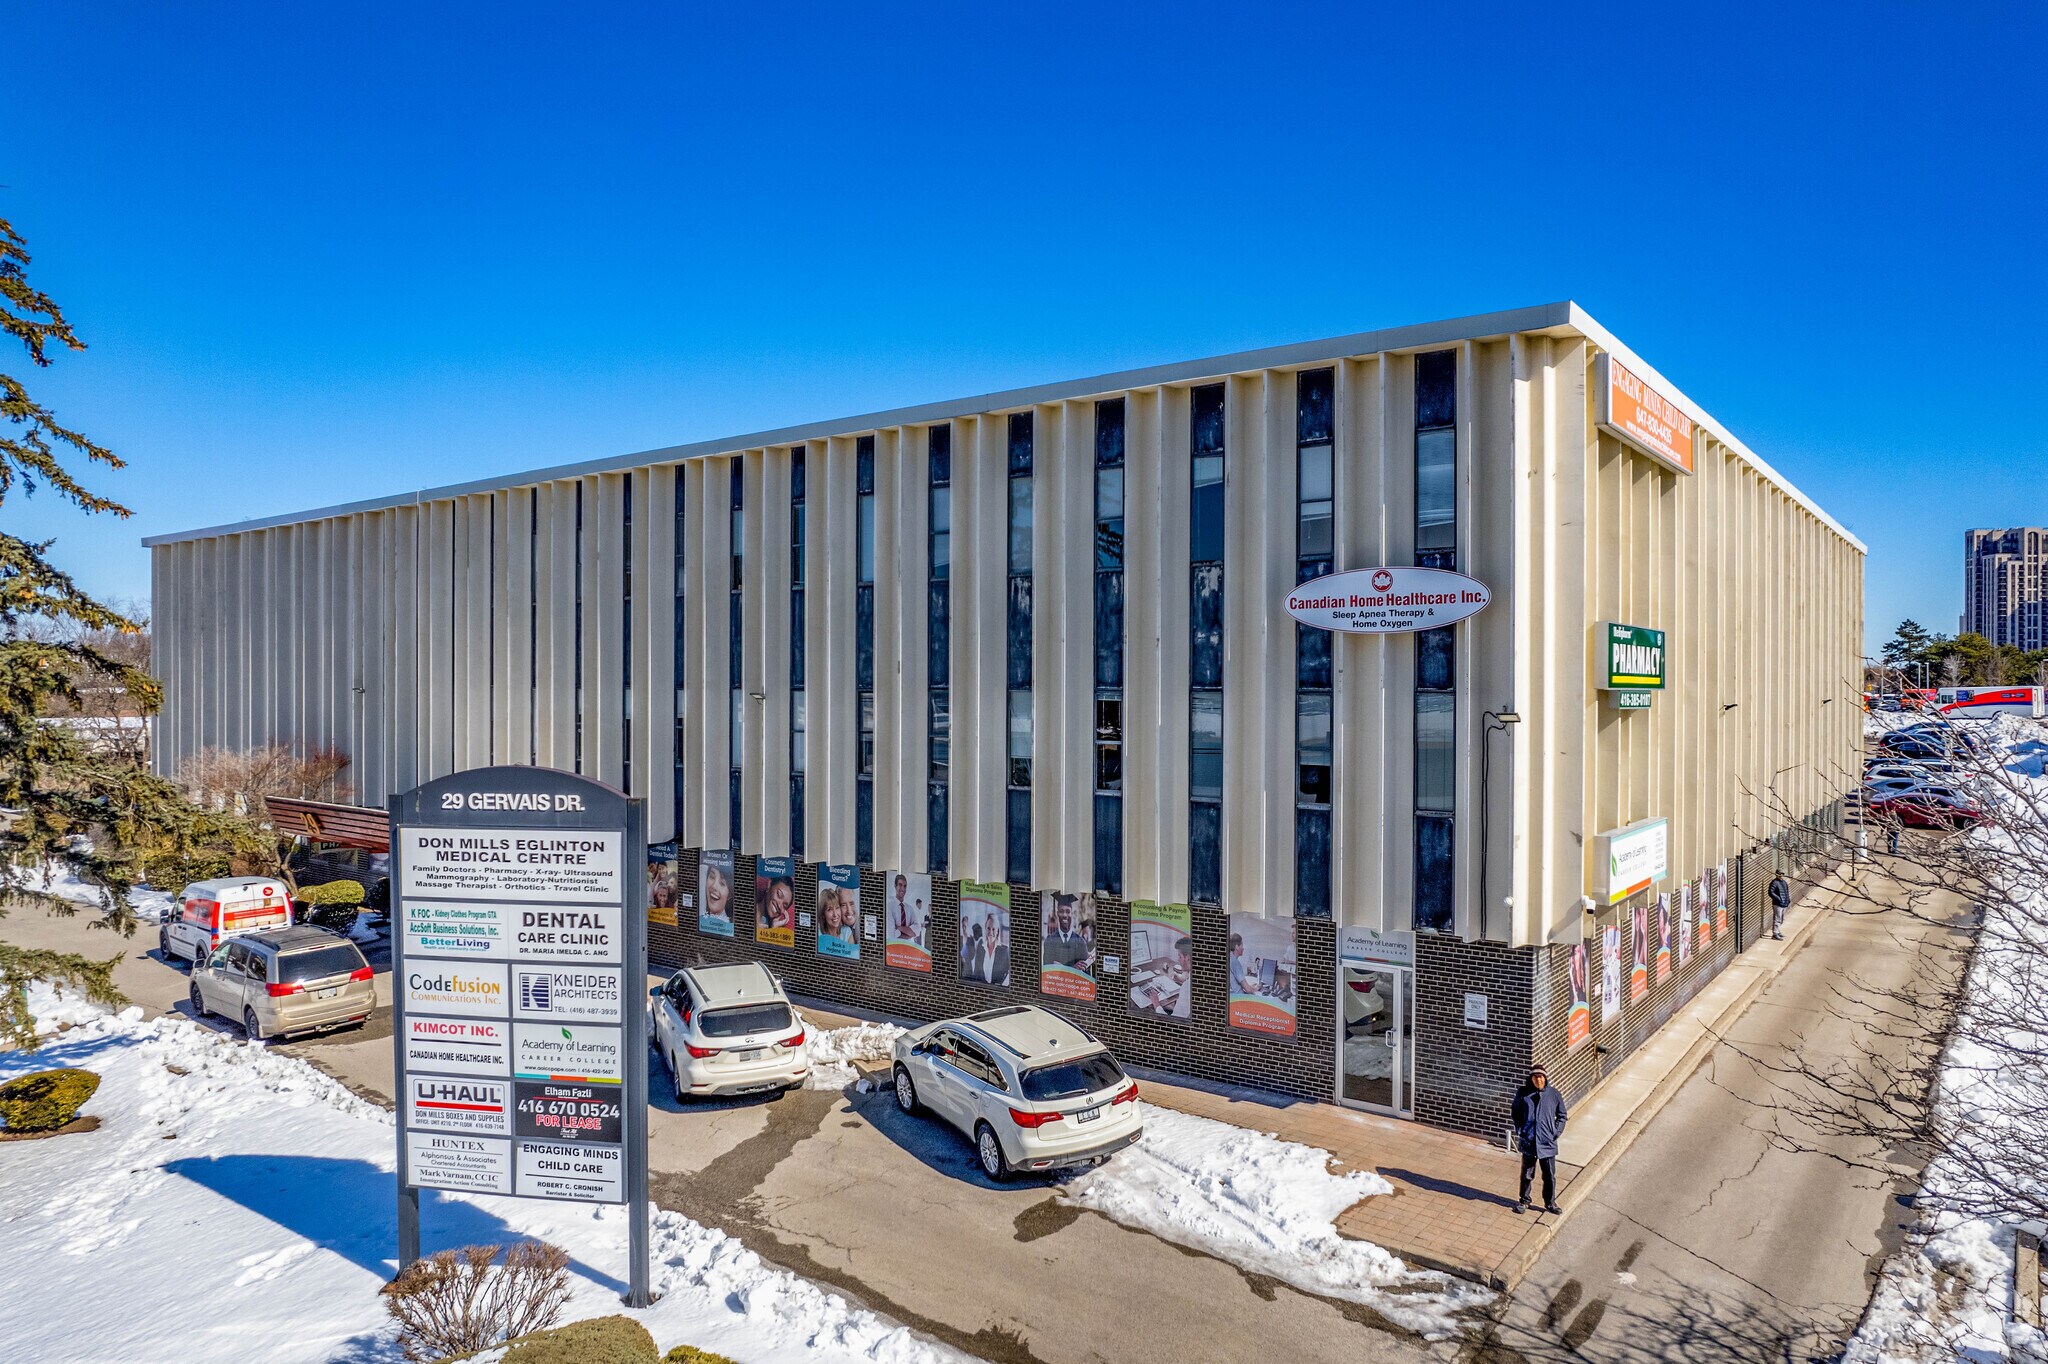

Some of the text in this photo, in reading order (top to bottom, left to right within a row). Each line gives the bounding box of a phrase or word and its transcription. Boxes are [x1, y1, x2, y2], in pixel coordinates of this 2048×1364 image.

[1612, 360, 1691, 440] ENGAGING MINDS CHILD CARE
[1290, 590, 1486, 610] Canadian Home Healthcare Inc.
[1332, 608, 1435, 619] Sleep Apnea Therapy &
[1352, 619, 1413, 629] Home Oxygen
[1612, 643, 1661, 675] PHARMACY
[441, 792, 586, 811] 29 GERVAIS DR.
[418, 837, 605, 852] DON MILLS EGLINTON
[436, 851, 586, 865] MEDICAL CENTRE
[412, 865, 440, 874] Family
[484, 867, 528, 876] Pharmacy
[564, 869, 613, 877] Ultrasound
[426, 873, 489, 882] Mammography
[831, 874, 849, 882] Gums?
[415, 881, 609, 893] Massage Therapist Orthotics Travel Clinic
[411, 908, 416, 918] K
[417, 909, 431, 918] FOC
[435, 910, 450, 919] Kidney
[451, 910, 467, 919] Clothes
[468, 910, 486, 920] Program
[523, 912, 605, 929] DENTAL
[410, 922, 499, 937] AccSoft Business Solutions, Inc.
[421, 937, 490, 950] BetterLiving
[518, 932, 609, 945] CARE CLINIC
[1347, 936, 1374, 946] Academy
[1381, 940, 1408, 950] Learning
[554, 974, 617, 989] KNEIDER
[554, 989, 618, 1000] ARCHITECTS
[1239, 1019, 1286, 1031] Diploma Program
[1256, 1015, 1290, 1025] Receptionist
[413, 1022, 498, 1037] KIMCOT INC.
[522, 1039, 616, 1055] Academy of Learning
[410, 1050, 504, 1065] CANADIAN HOME HEALTHCARE INC.
[569, 1057, 616, 1065] COLLEGE
[418, 1083, 501, 1103] U-HAUL
[545, 1086, 592, 1098] Elham Fazli
[518, 1099, 620, 1118] 416 670 0524
[428, 1111, 444, 1119] MILLS
[446, 1112, 464, 1120] BOXES
[465, 1113, 477, 1121] AND
[477, 1114, 504, 1123] SUPPLIES
[535, 1114, 602, 1130] FOR LEASE
[432, 1138, 485, 1151] HUNTEX
[421, 1151, 455, 1160] Alphonsus
[463, 1156, 497, 1164] Associates
[523, 1144, 618, 1160] ENGAGING MINDS
[457, 1161, 486, 1169] Accountants
[538, 1160, 603, 1174] CHILD CARE
[420, 1169, 441, 1177] Mark
[420, 1177, 452, 1185] Immigration
[470, 1181, 498, 1189] Consulting
[573, 1184, 603, 1192] CRONISH
